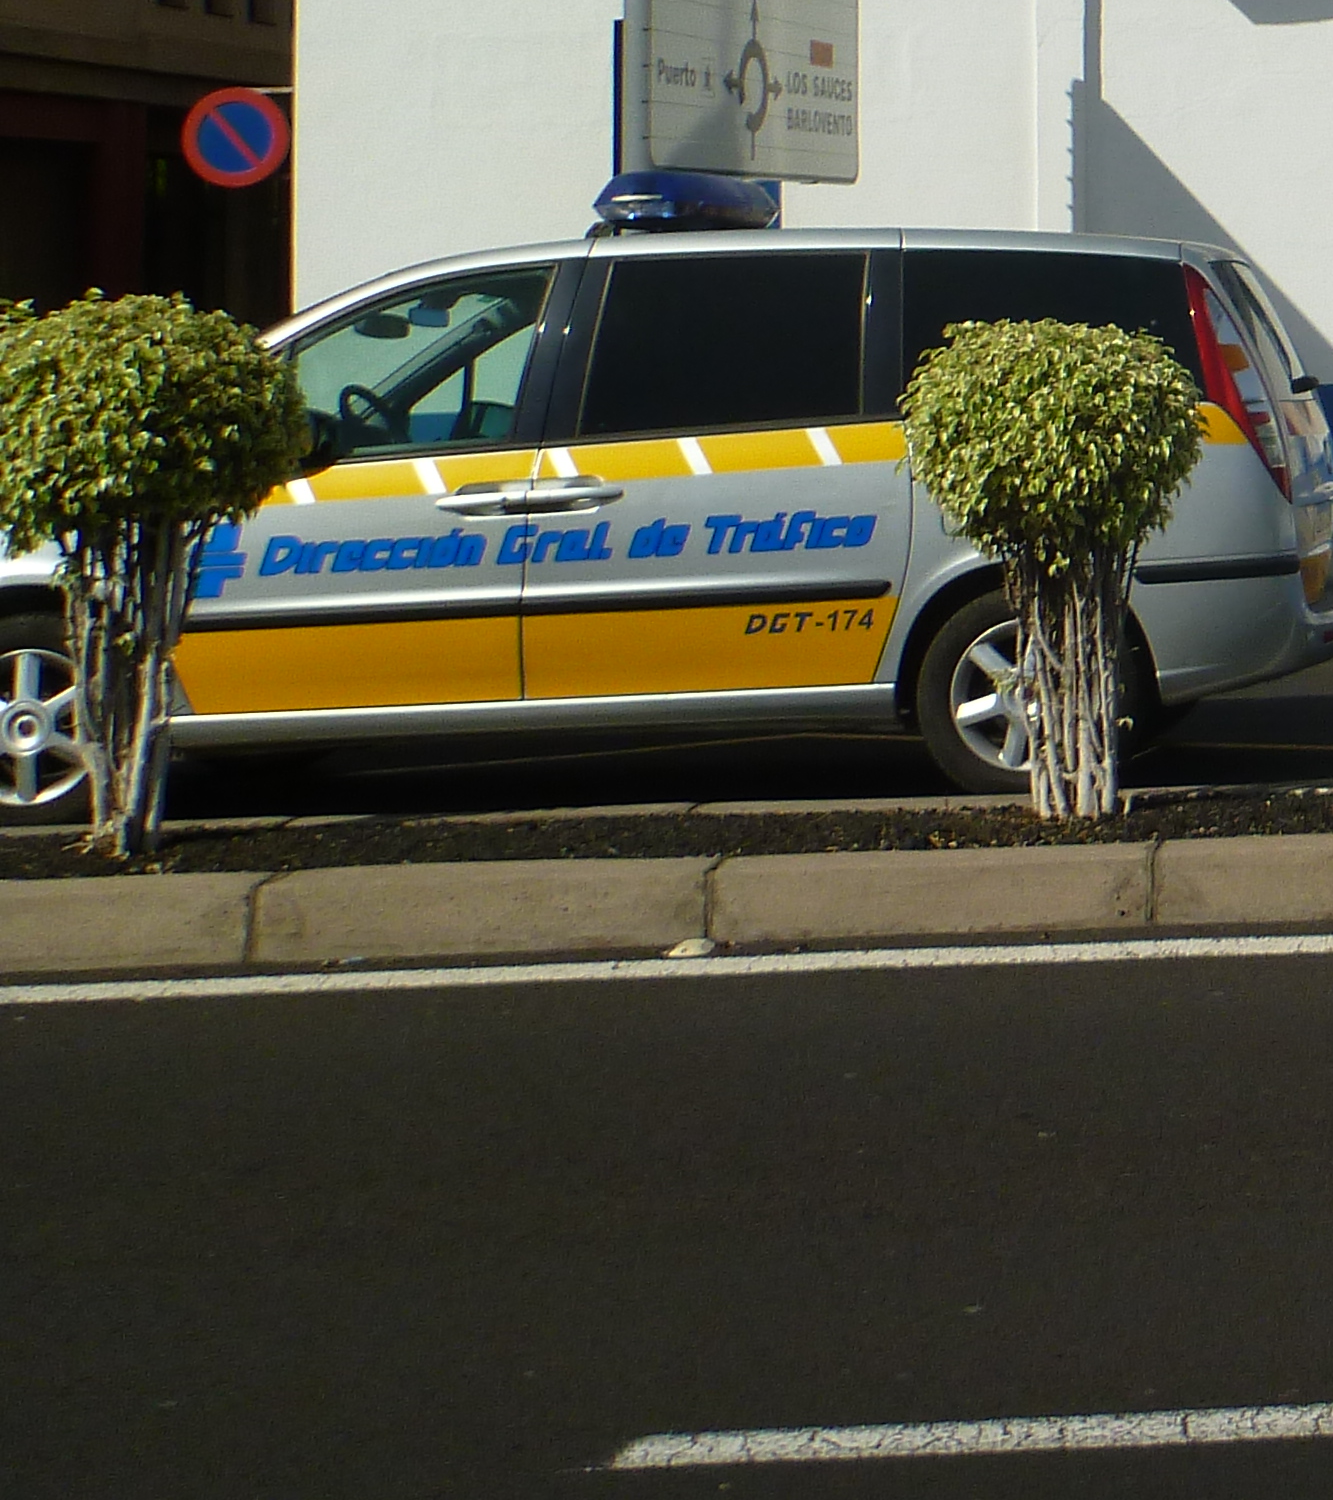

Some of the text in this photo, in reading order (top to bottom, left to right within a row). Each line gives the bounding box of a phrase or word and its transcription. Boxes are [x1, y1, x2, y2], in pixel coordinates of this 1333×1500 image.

[657, 57, 697, 88] Puerto
[786, 70, 853, 102] LOS SAUCES
[786, 106, 853, 137] BARLOVENTO
[259, 528, 488, 577] Dirección
[629, 517, 691, 559] de
[705, 510, 878, 555] Tráfico
[745, 608, 874, 636] DGT-174
